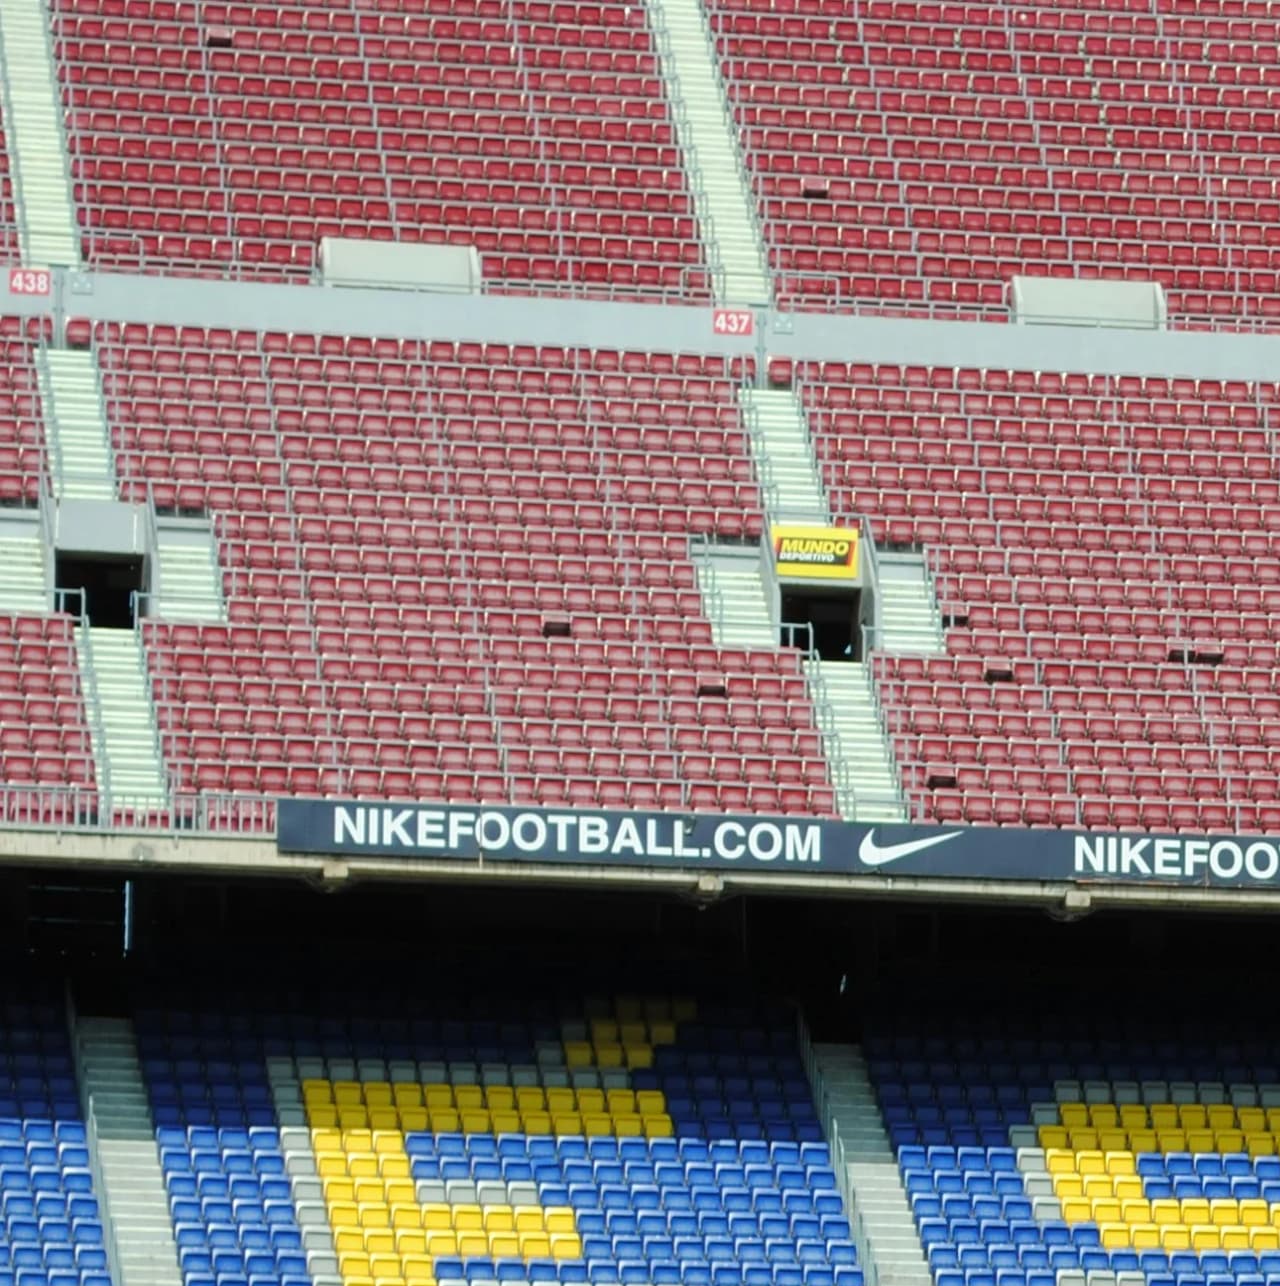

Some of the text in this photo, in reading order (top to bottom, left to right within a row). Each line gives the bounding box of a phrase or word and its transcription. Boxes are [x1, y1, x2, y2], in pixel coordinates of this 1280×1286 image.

[11, 272, 49, 293] 438
[714, 312, 750, 333] 437
[781, 538, 849, 556] MUNDO
[779, 552, 834, 564] DEPORTIVO
[334, 807, 821, 862] NIKEFOOTBALL.COM
